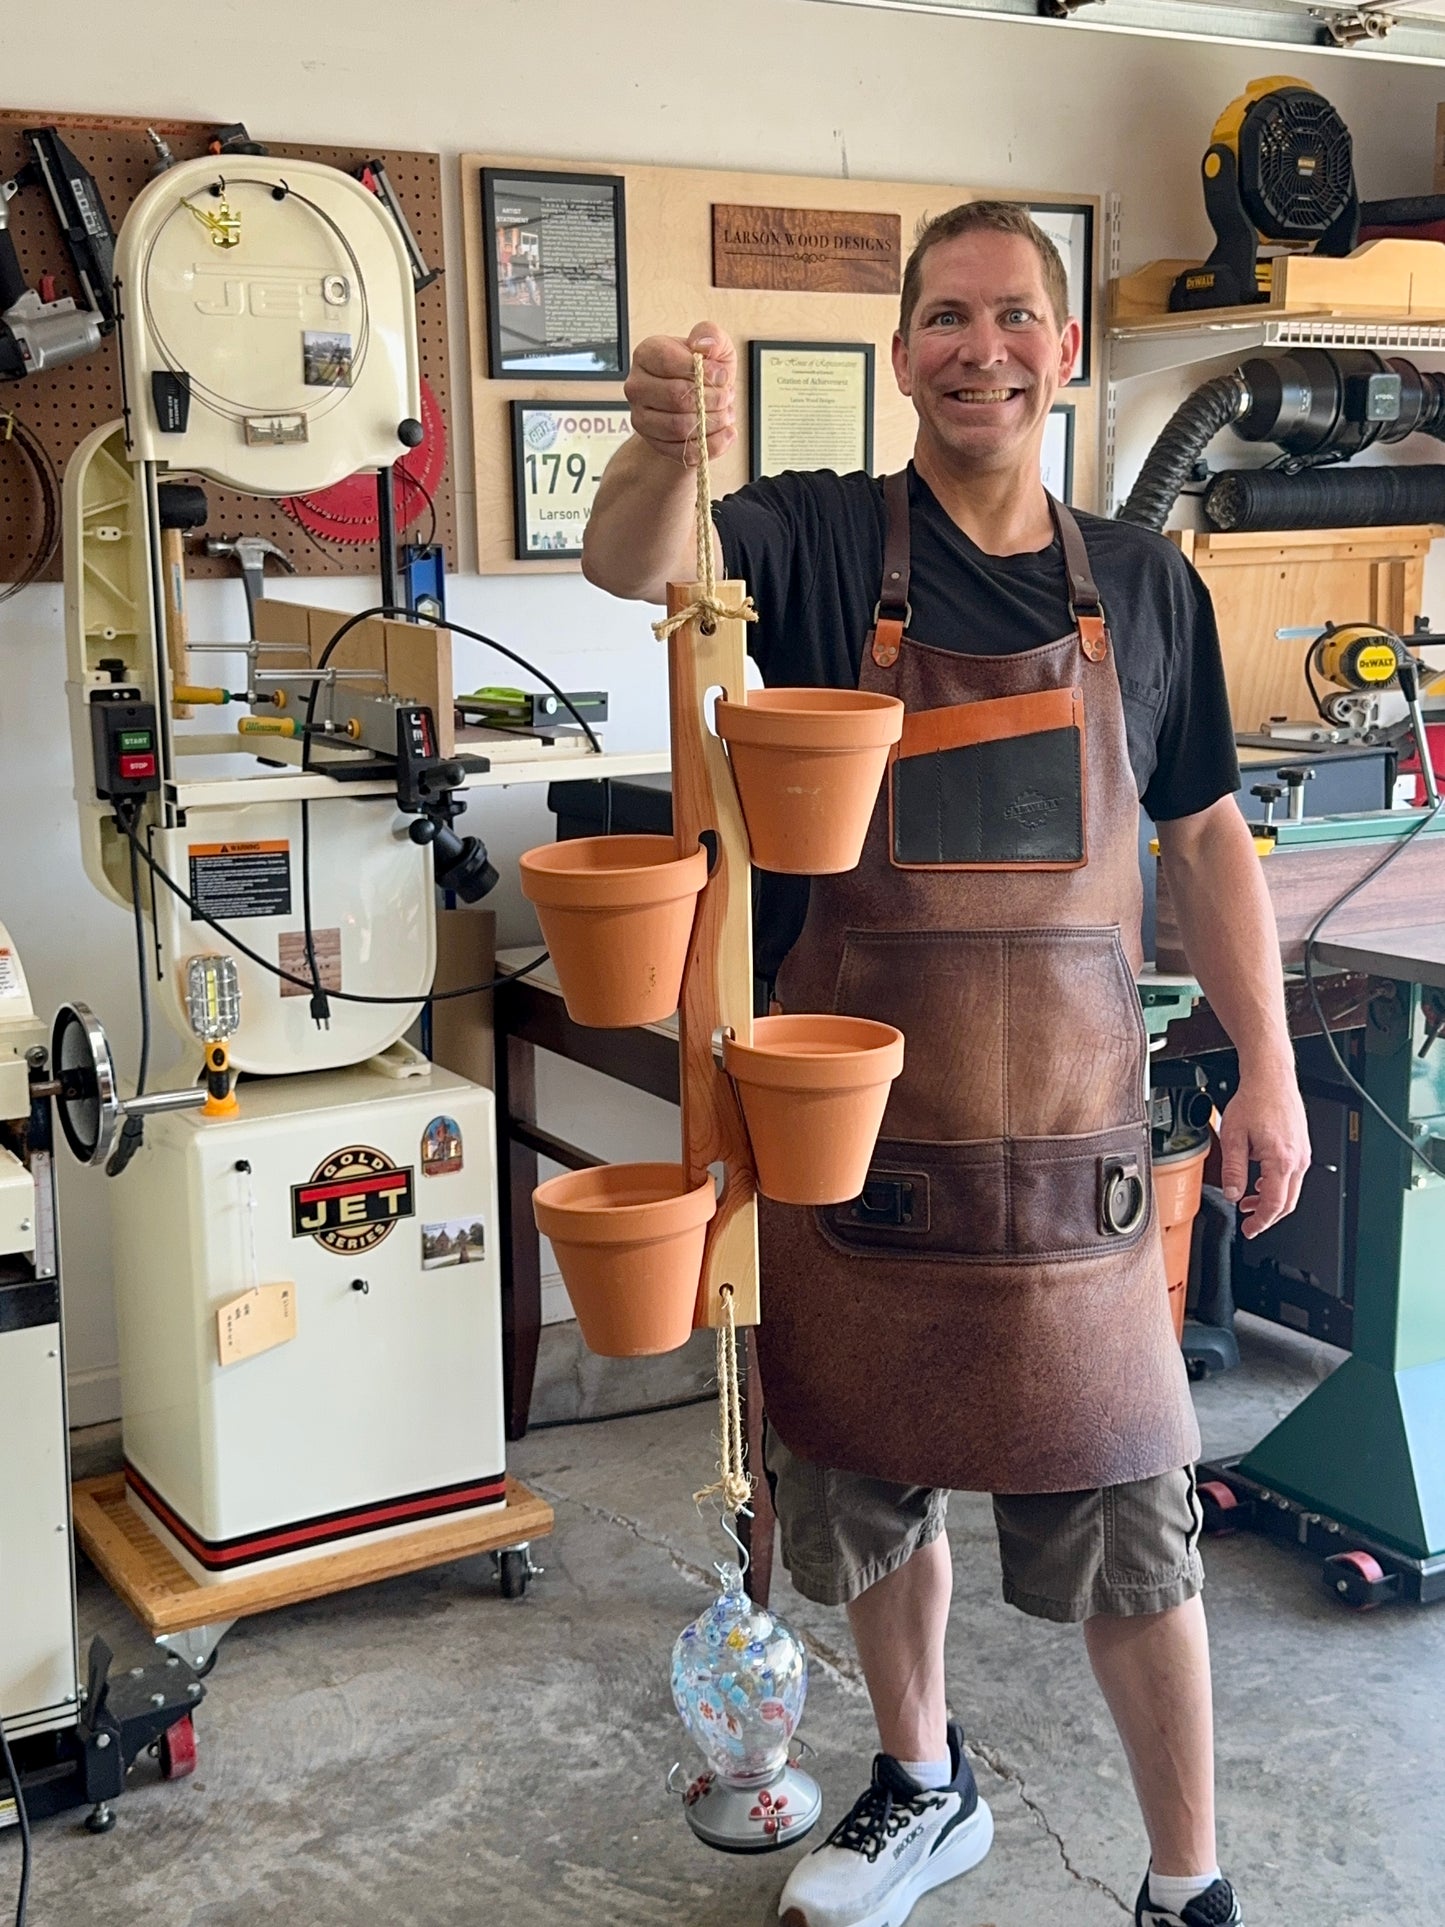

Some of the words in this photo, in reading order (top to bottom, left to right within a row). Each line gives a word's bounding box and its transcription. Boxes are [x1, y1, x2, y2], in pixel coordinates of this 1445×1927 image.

[723, 229, 779, 246] LARSON
[785, 233, 829, 249] WOOD
[834, 237, 892, 251] DESIGNS
[539, 508, 580, 520] Larson
[124, 737, 148, 745] START
[410, 713, 426, 758] JET
[129, 762, 149, 770] STOP
[230, 843, 261, 852] WARNING
[323, 1152, 385, 1178] GOLD
[300, 1186, 408, 1230] JET
[325, 1223, 386, 1250] SERIES
[892, 1823, 925, 1860] BROOKS
